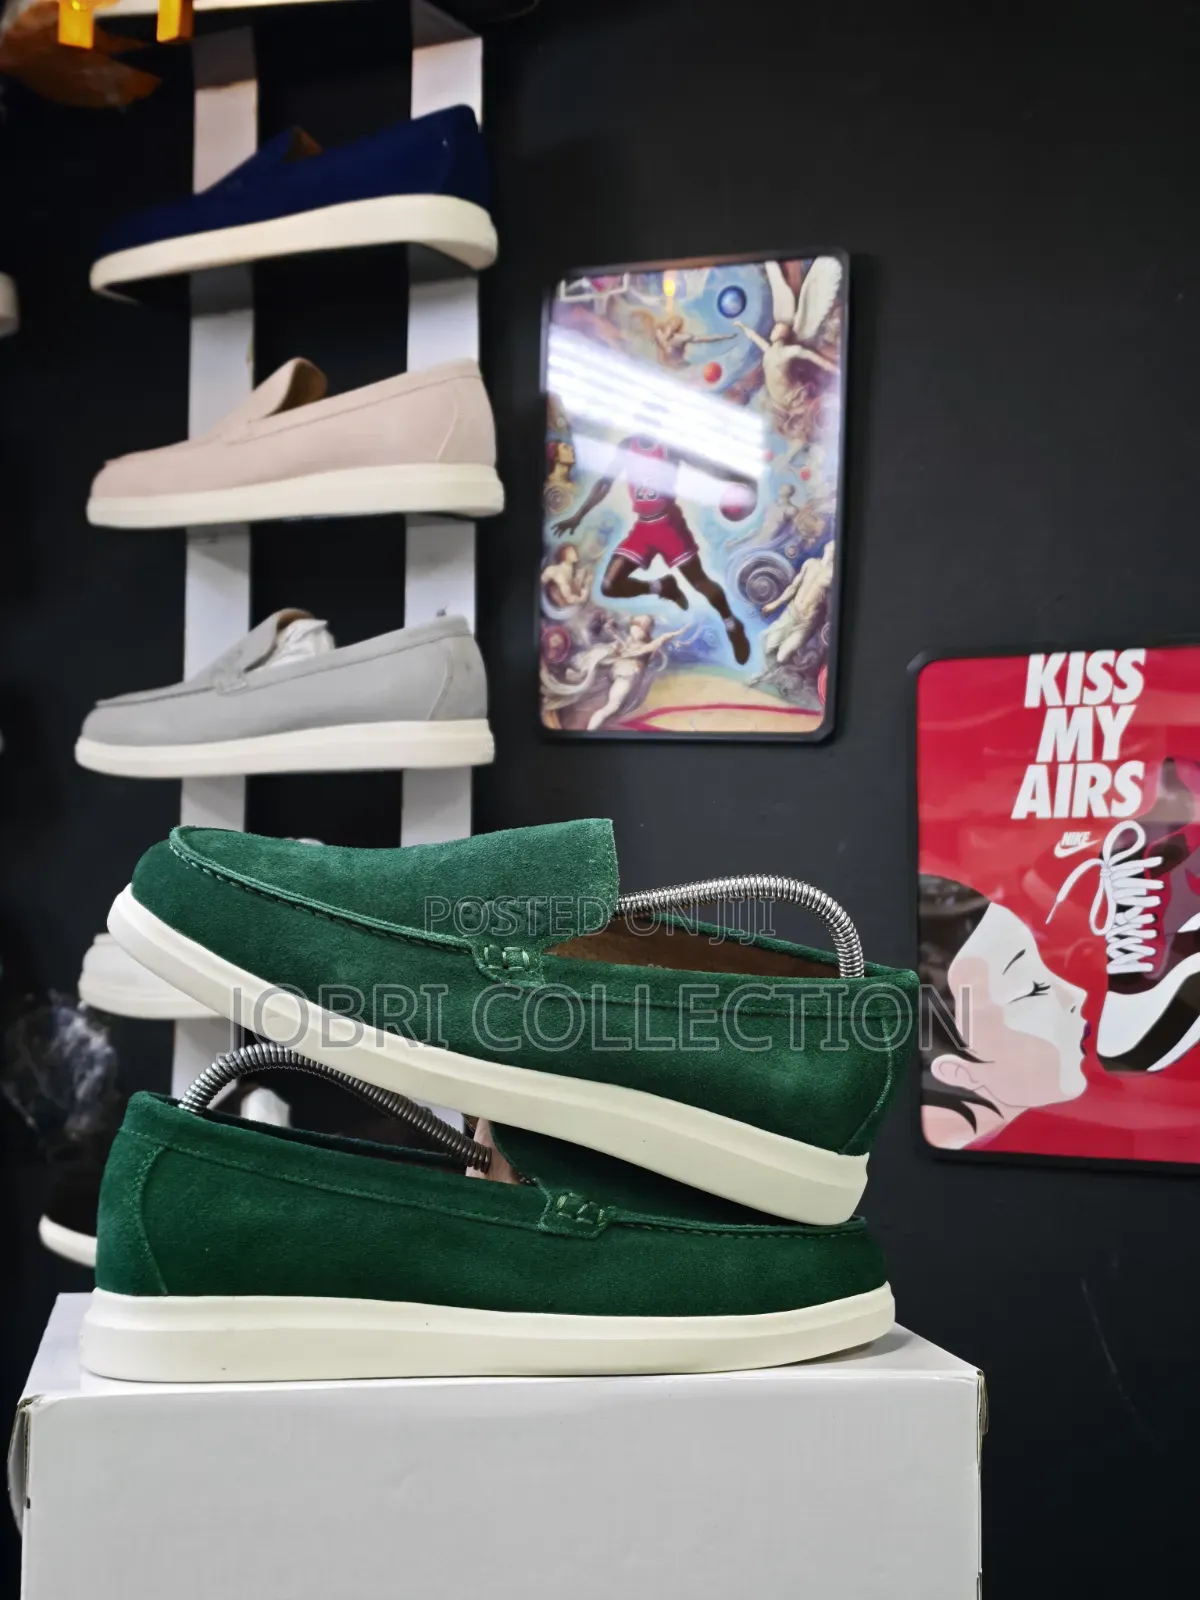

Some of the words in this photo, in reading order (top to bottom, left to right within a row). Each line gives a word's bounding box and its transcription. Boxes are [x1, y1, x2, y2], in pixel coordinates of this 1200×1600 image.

[1024, 648, 1147, 708] KISS
[1036, 704, 1137, 763] MY
[1011, 760, 1145, 819] AIRS
[1061, 831, 1092, 846] NIKE
